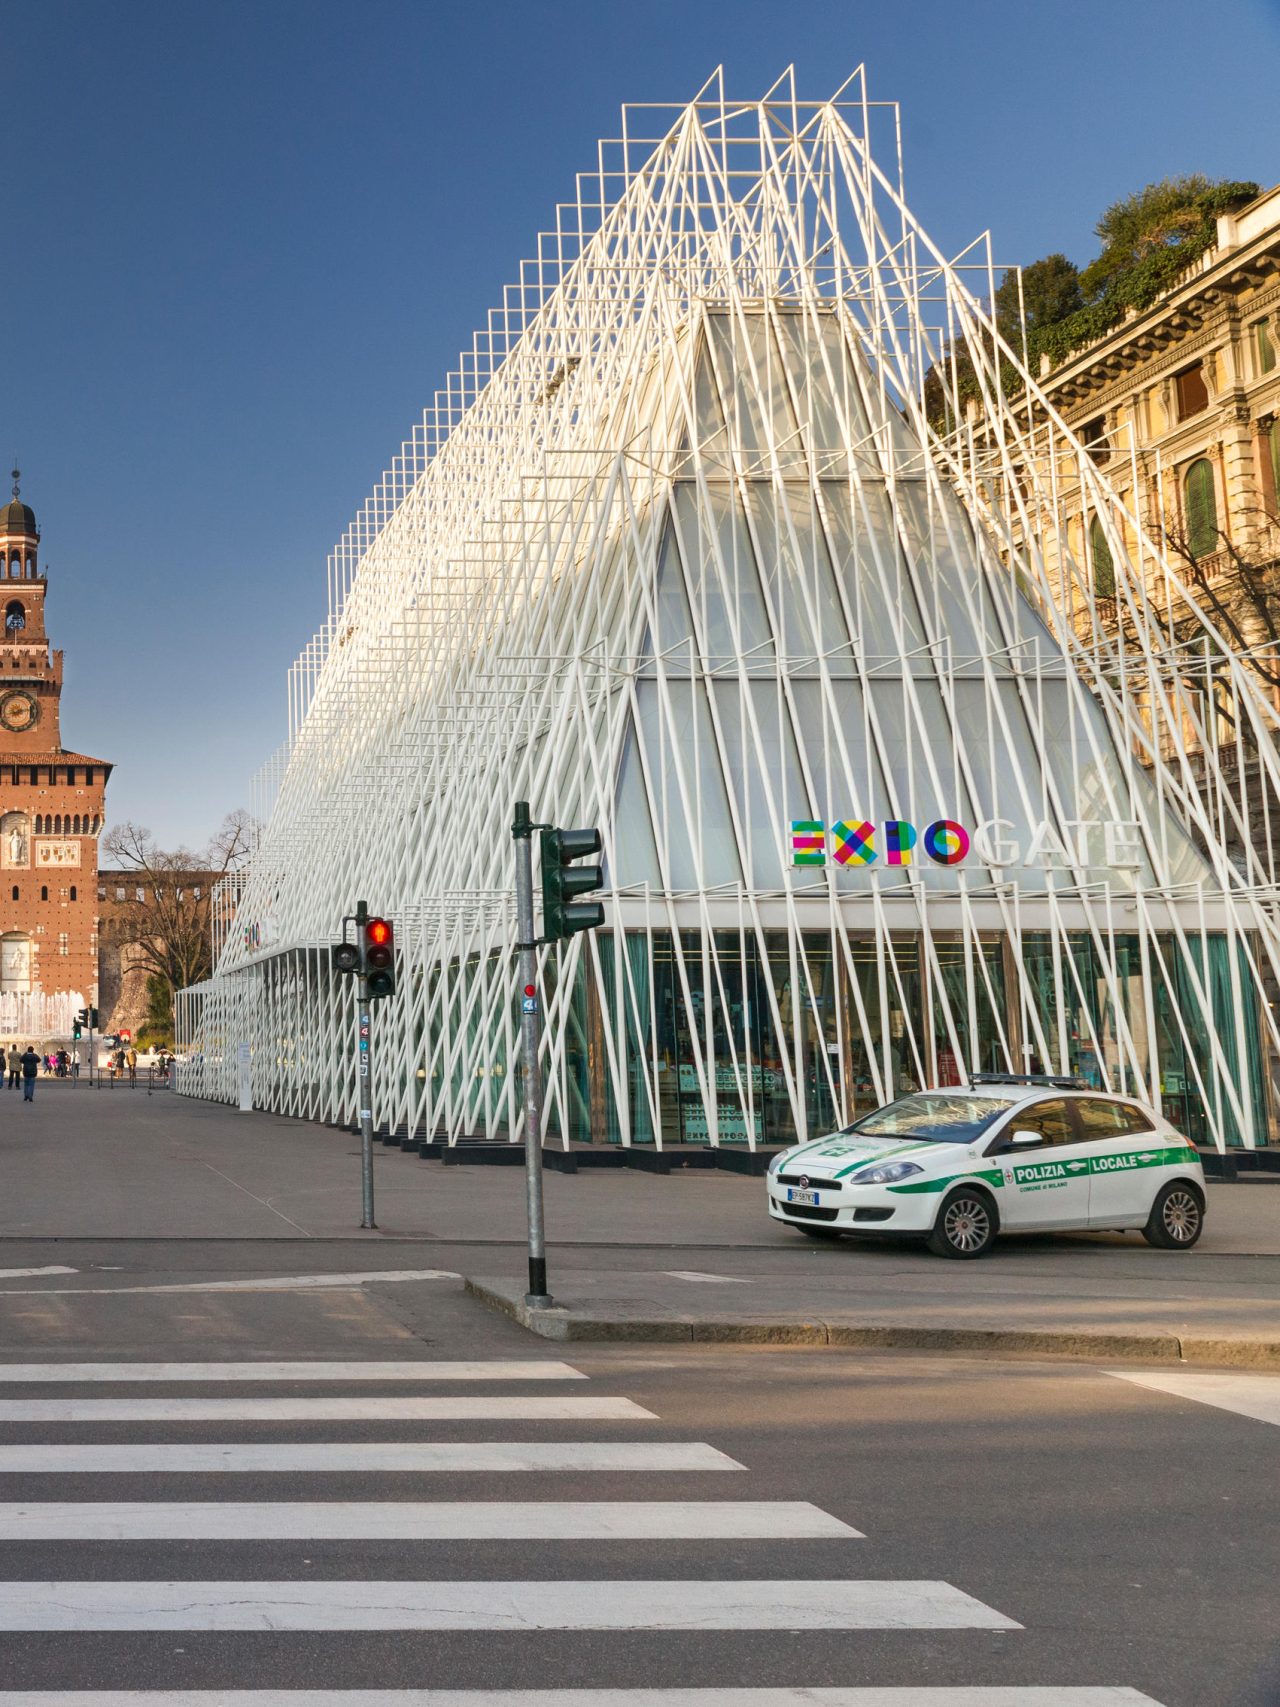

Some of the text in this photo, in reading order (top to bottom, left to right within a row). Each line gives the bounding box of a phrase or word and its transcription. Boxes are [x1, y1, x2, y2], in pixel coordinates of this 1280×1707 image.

[1016, 1155, 1138, 1182] POLIZIA LOCALE
[1019, 1185, 1041, 1193] COMUNE
[1048, 1181, 1068, 1189] MILANO
